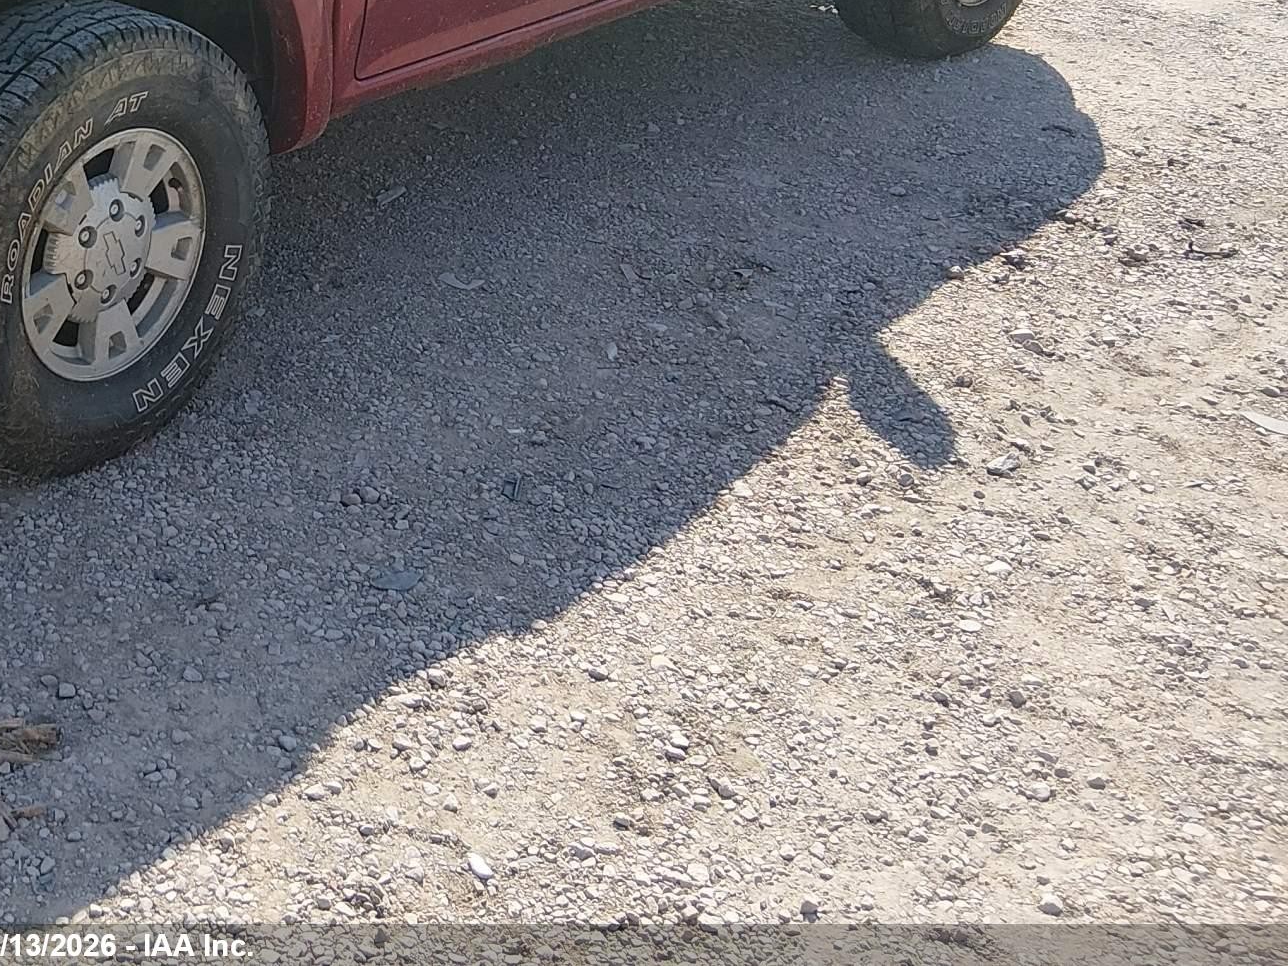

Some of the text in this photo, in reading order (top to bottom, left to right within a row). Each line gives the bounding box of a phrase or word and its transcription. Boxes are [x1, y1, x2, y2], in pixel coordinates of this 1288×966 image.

[0, 90, 149, 304] ROADIAN AT
[132, 244, 244, 413] NEXEN
